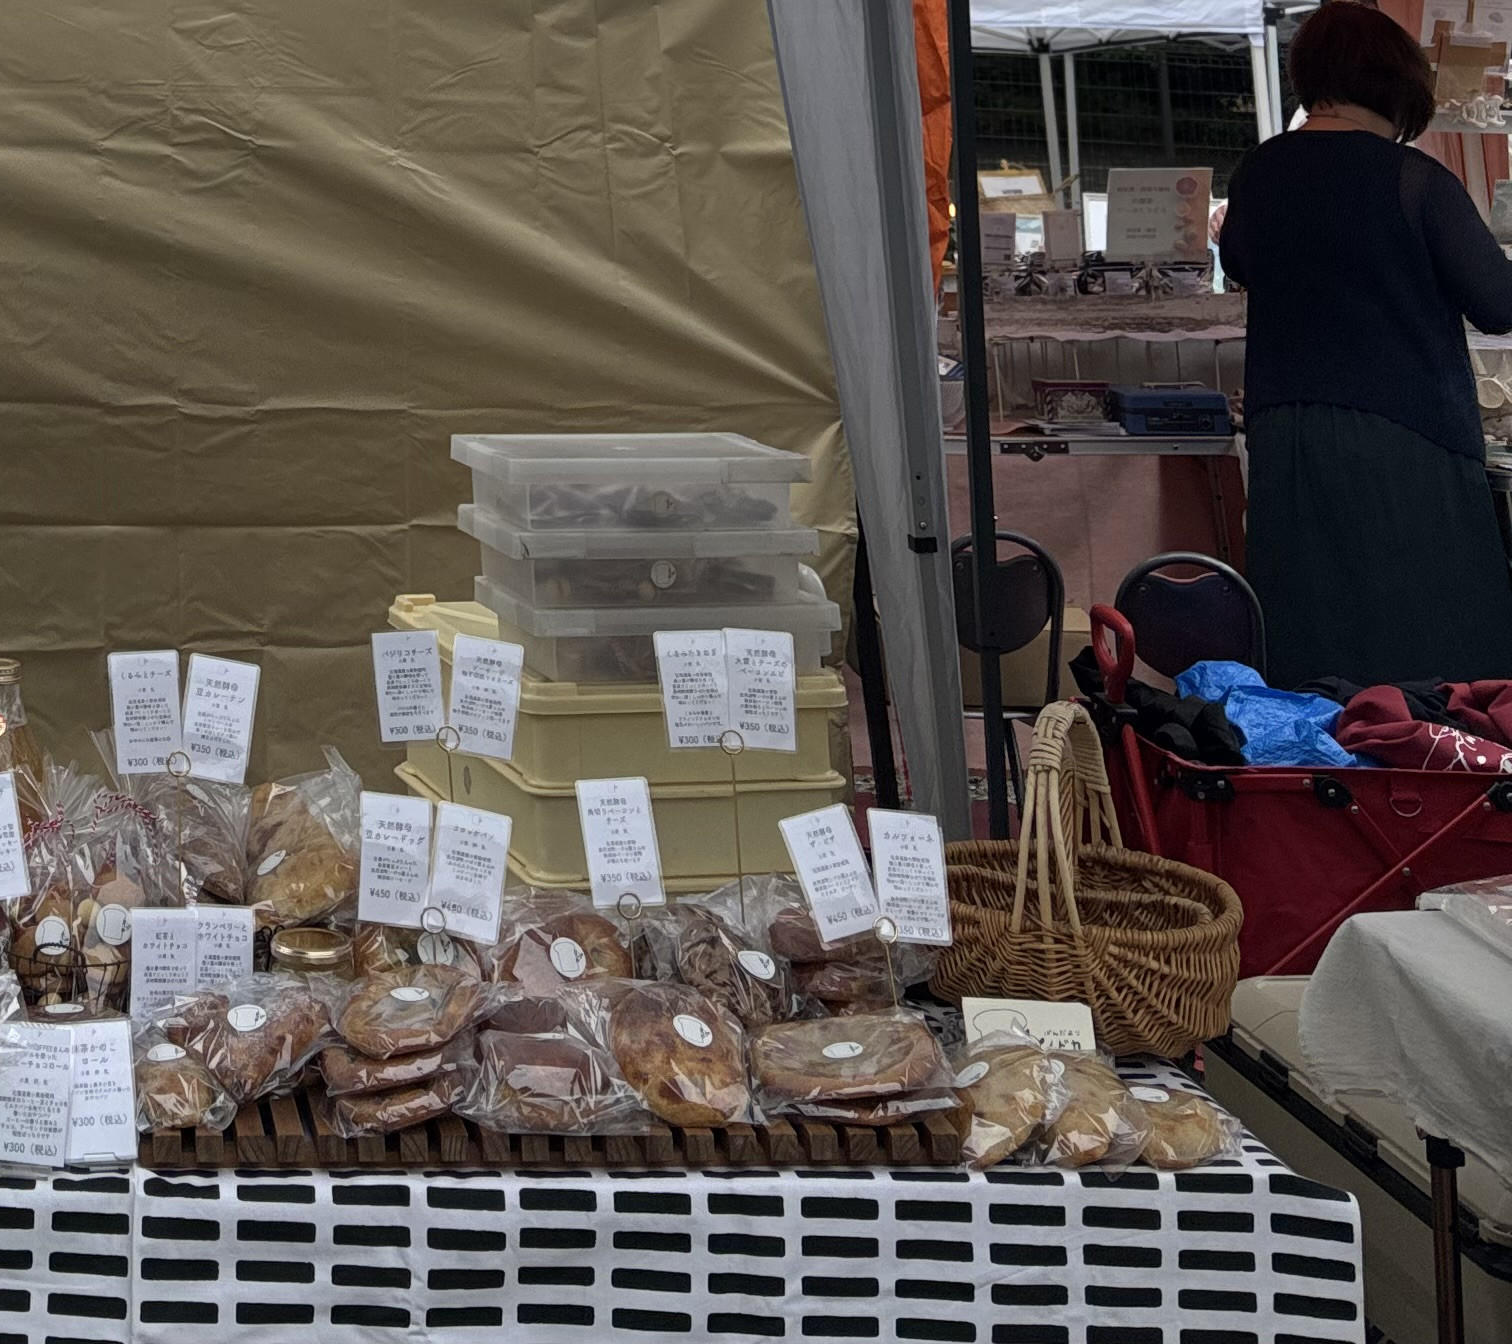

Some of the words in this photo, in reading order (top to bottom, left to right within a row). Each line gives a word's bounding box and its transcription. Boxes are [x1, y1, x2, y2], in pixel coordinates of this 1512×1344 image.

[205, 679, 238, 691] 天然酵母
[377, 820, 413, 832] 天然酵母
[198, 933, 248, 942] ホワイトチョコ
[82, 1056, 109, 1065] ロール
